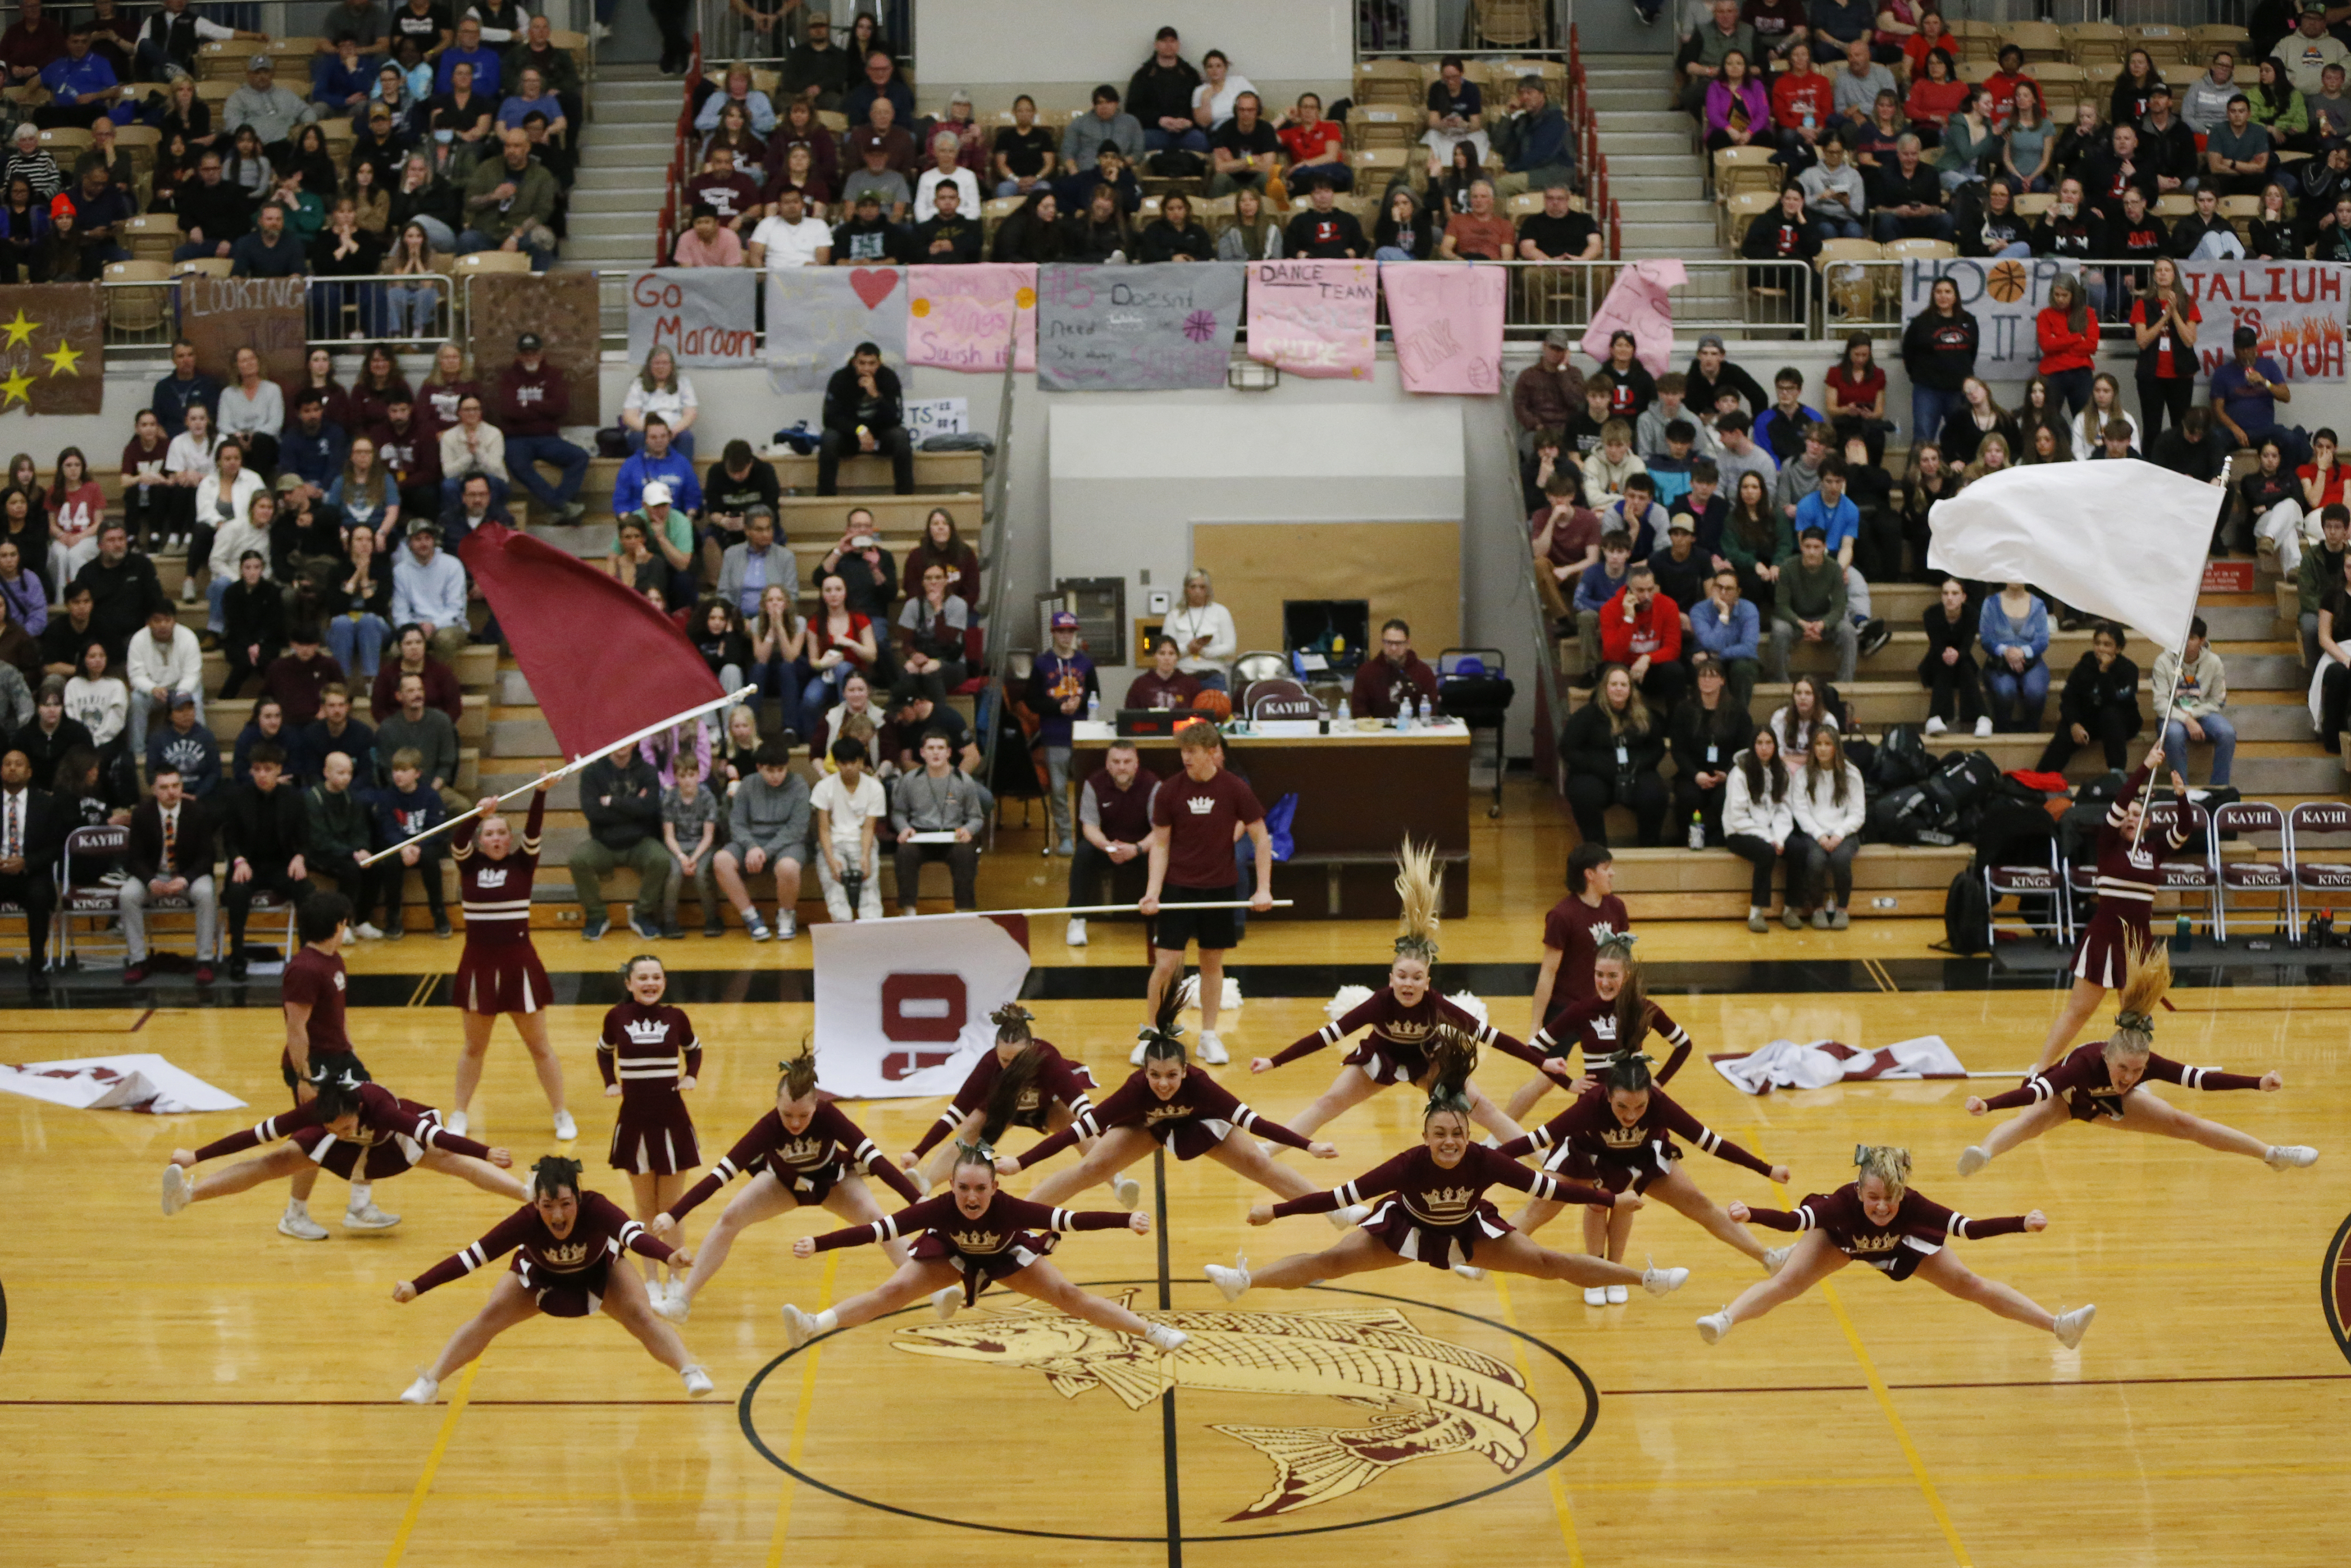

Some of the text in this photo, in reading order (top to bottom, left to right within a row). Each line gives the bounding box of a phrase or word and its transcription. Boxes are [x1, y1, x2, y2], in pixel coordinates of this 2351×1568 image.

[1260, 263, 1323, 283] DANCE
[1042, 265, 1096, 310] #5
[1318, 282, 1375, 300] TEAM
[190, 278, 305, 317] LOOKING
[654, 316, 756, 358] Maroon
[57, 501, 90, 531] 44
[1265, 701, 1310, 715] KAYHI
[2152, 811, 2198, 823] KAYI
[2228, 811, 2272, 824] KAYHI
[2302, 811, 2347, 823] KAYHI
[78, 833, 124, 848] KAYHI
[2012, 875, 2051, 887] KINGS
[2168, 873, 2206, 885] KINGS
[2242, 873, 2282, 885] KINGS
[72, 898, 113, 910] KINGS
